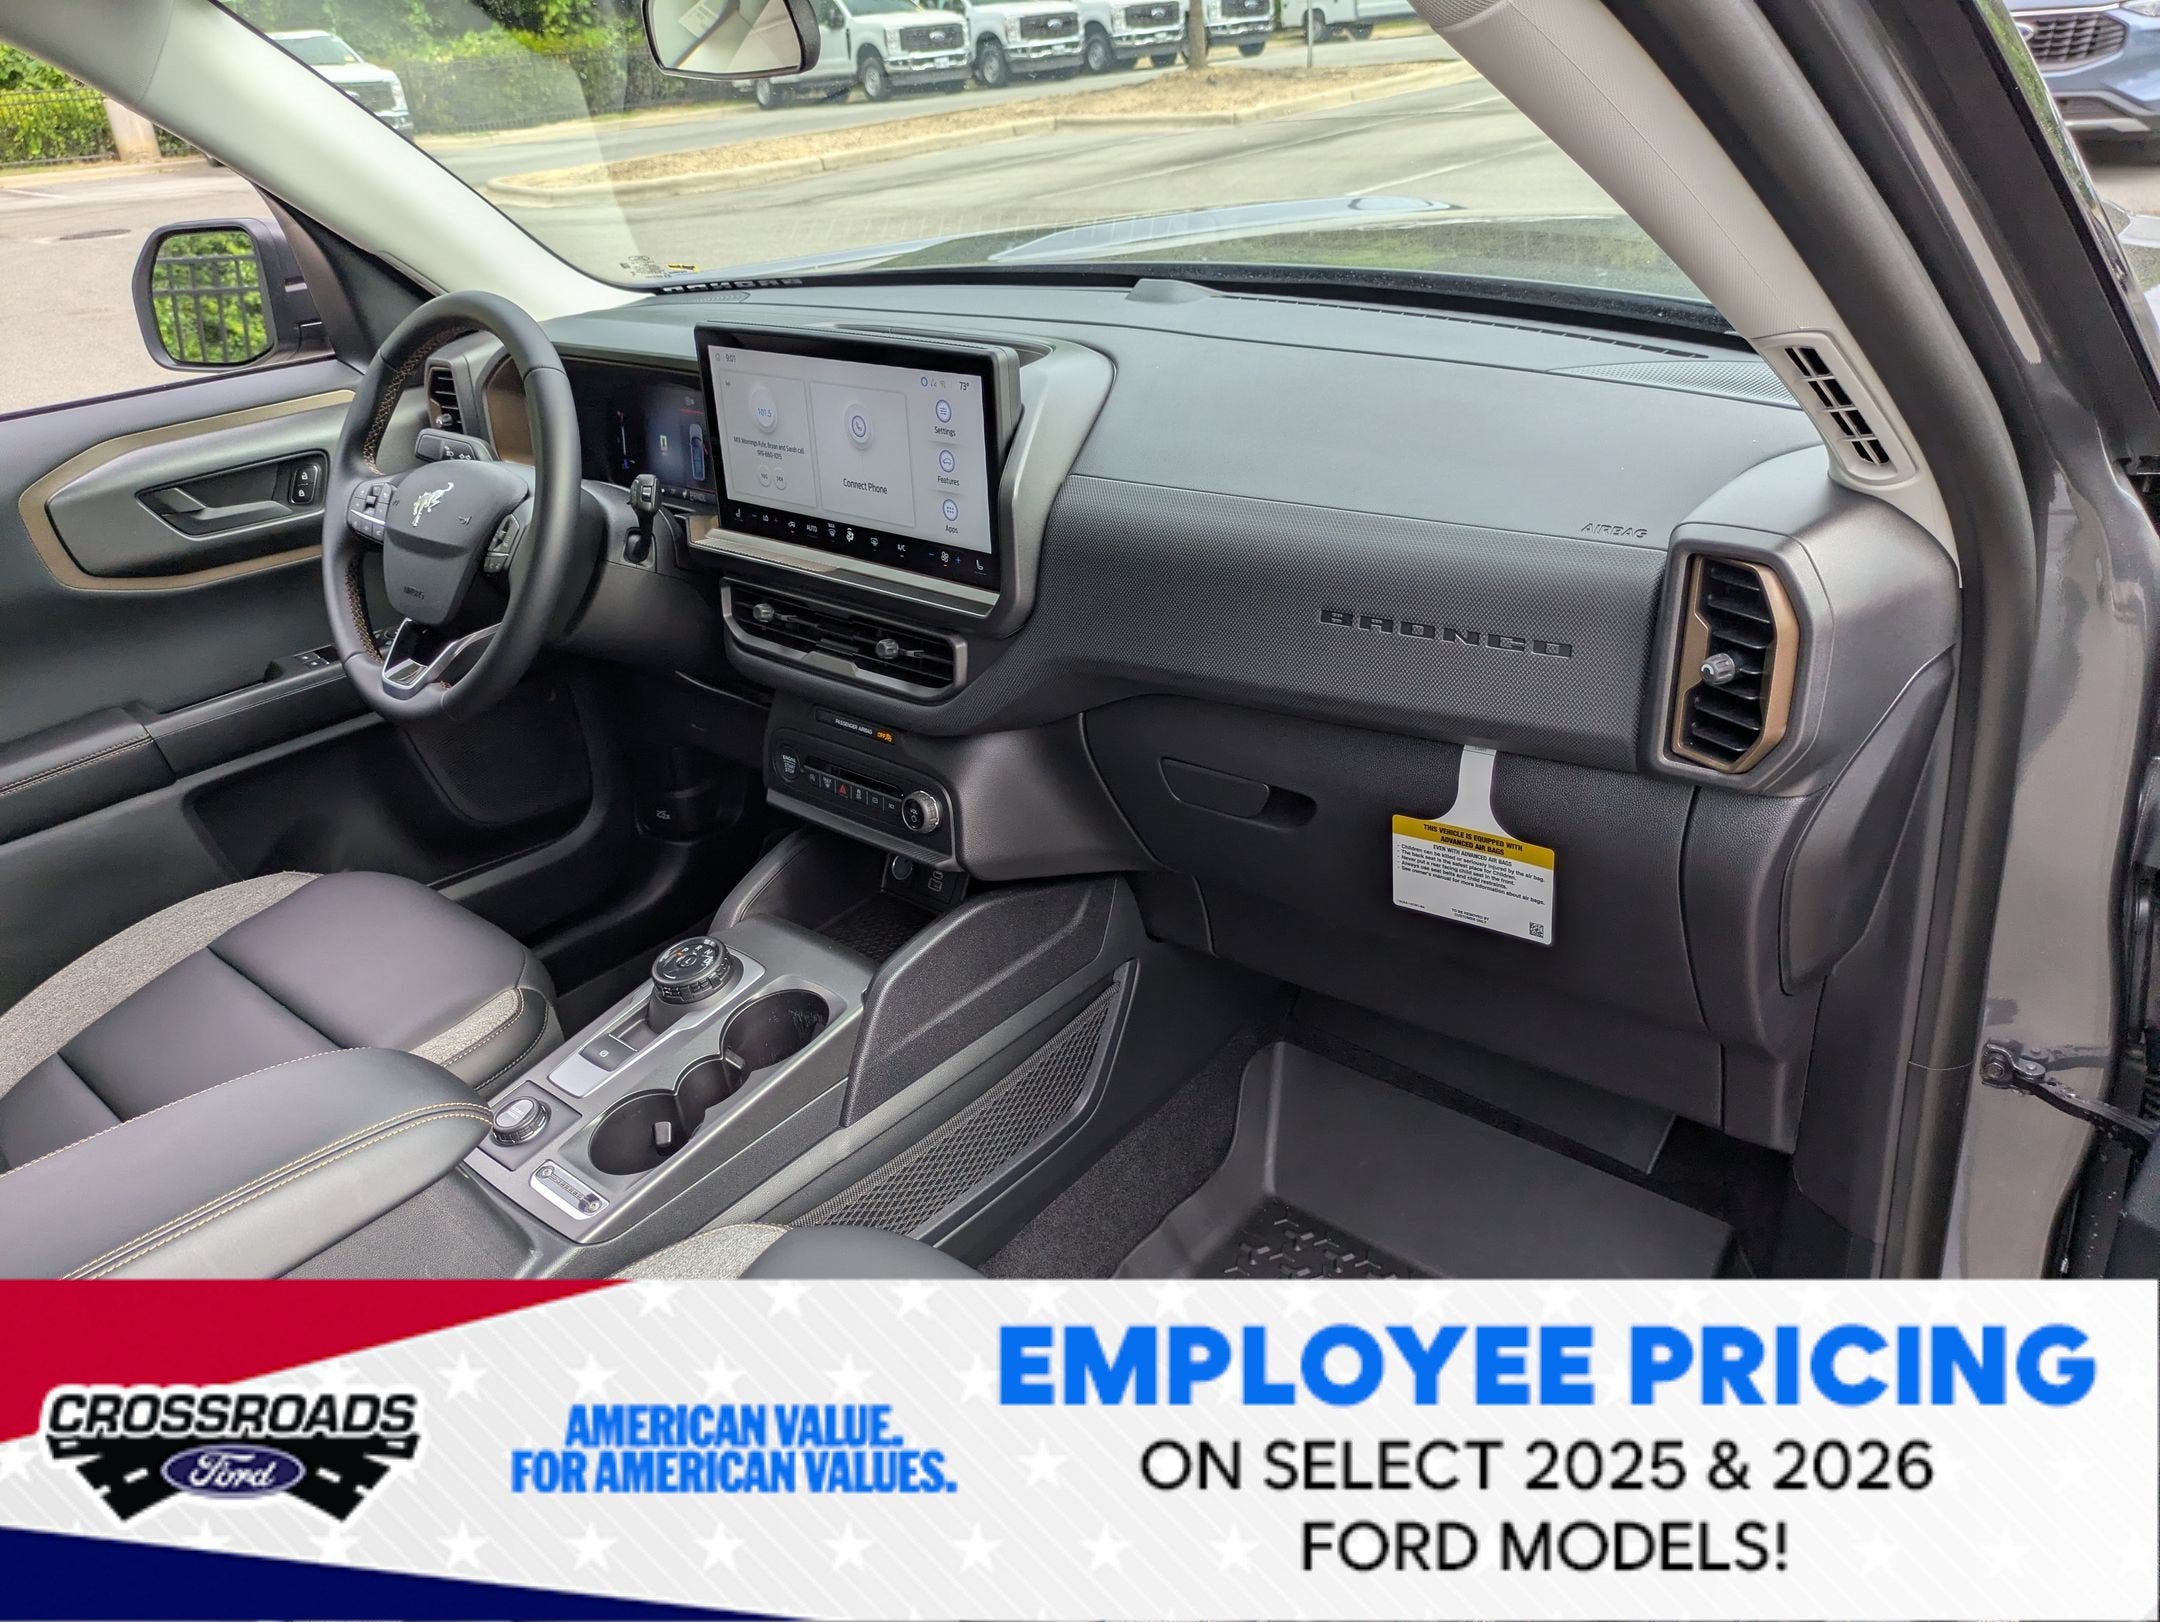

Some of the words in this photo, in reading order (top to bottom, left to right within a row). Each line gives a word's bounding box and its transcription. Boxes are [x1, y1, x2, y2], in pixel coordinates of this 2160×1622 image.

[758, 407, 772, 418] 101.5
[934, 426, 956, 438] Settings
[843, 478, 868, 491] Connect
[868, 482, 888, 494] Phone
[937, 476, 960, 486] Features
[945, 524, 958, 534] Apps
[1580, 522, 1648, 538] AIRBAG
[1320, 608, 1573, 658] BRONCO
[835, 718, 858, 731] PASSENGER
[1423, 823, 1437, 832] THIS
[1439, 827, 1463, 838] VEHICLE
[1473, 835, 1503, 847] EQUIPPED
[1506, 842, 1522, 851] WITH
[1401, 843, 1422, 852] Children
[1440, 835, 1473, 848] ADVANCED
[1475, 843, 1485, 851] AIR
[1487, 846, 1504, 855] BAGS
[1461, 850, 1487, 861] ADVANCED
